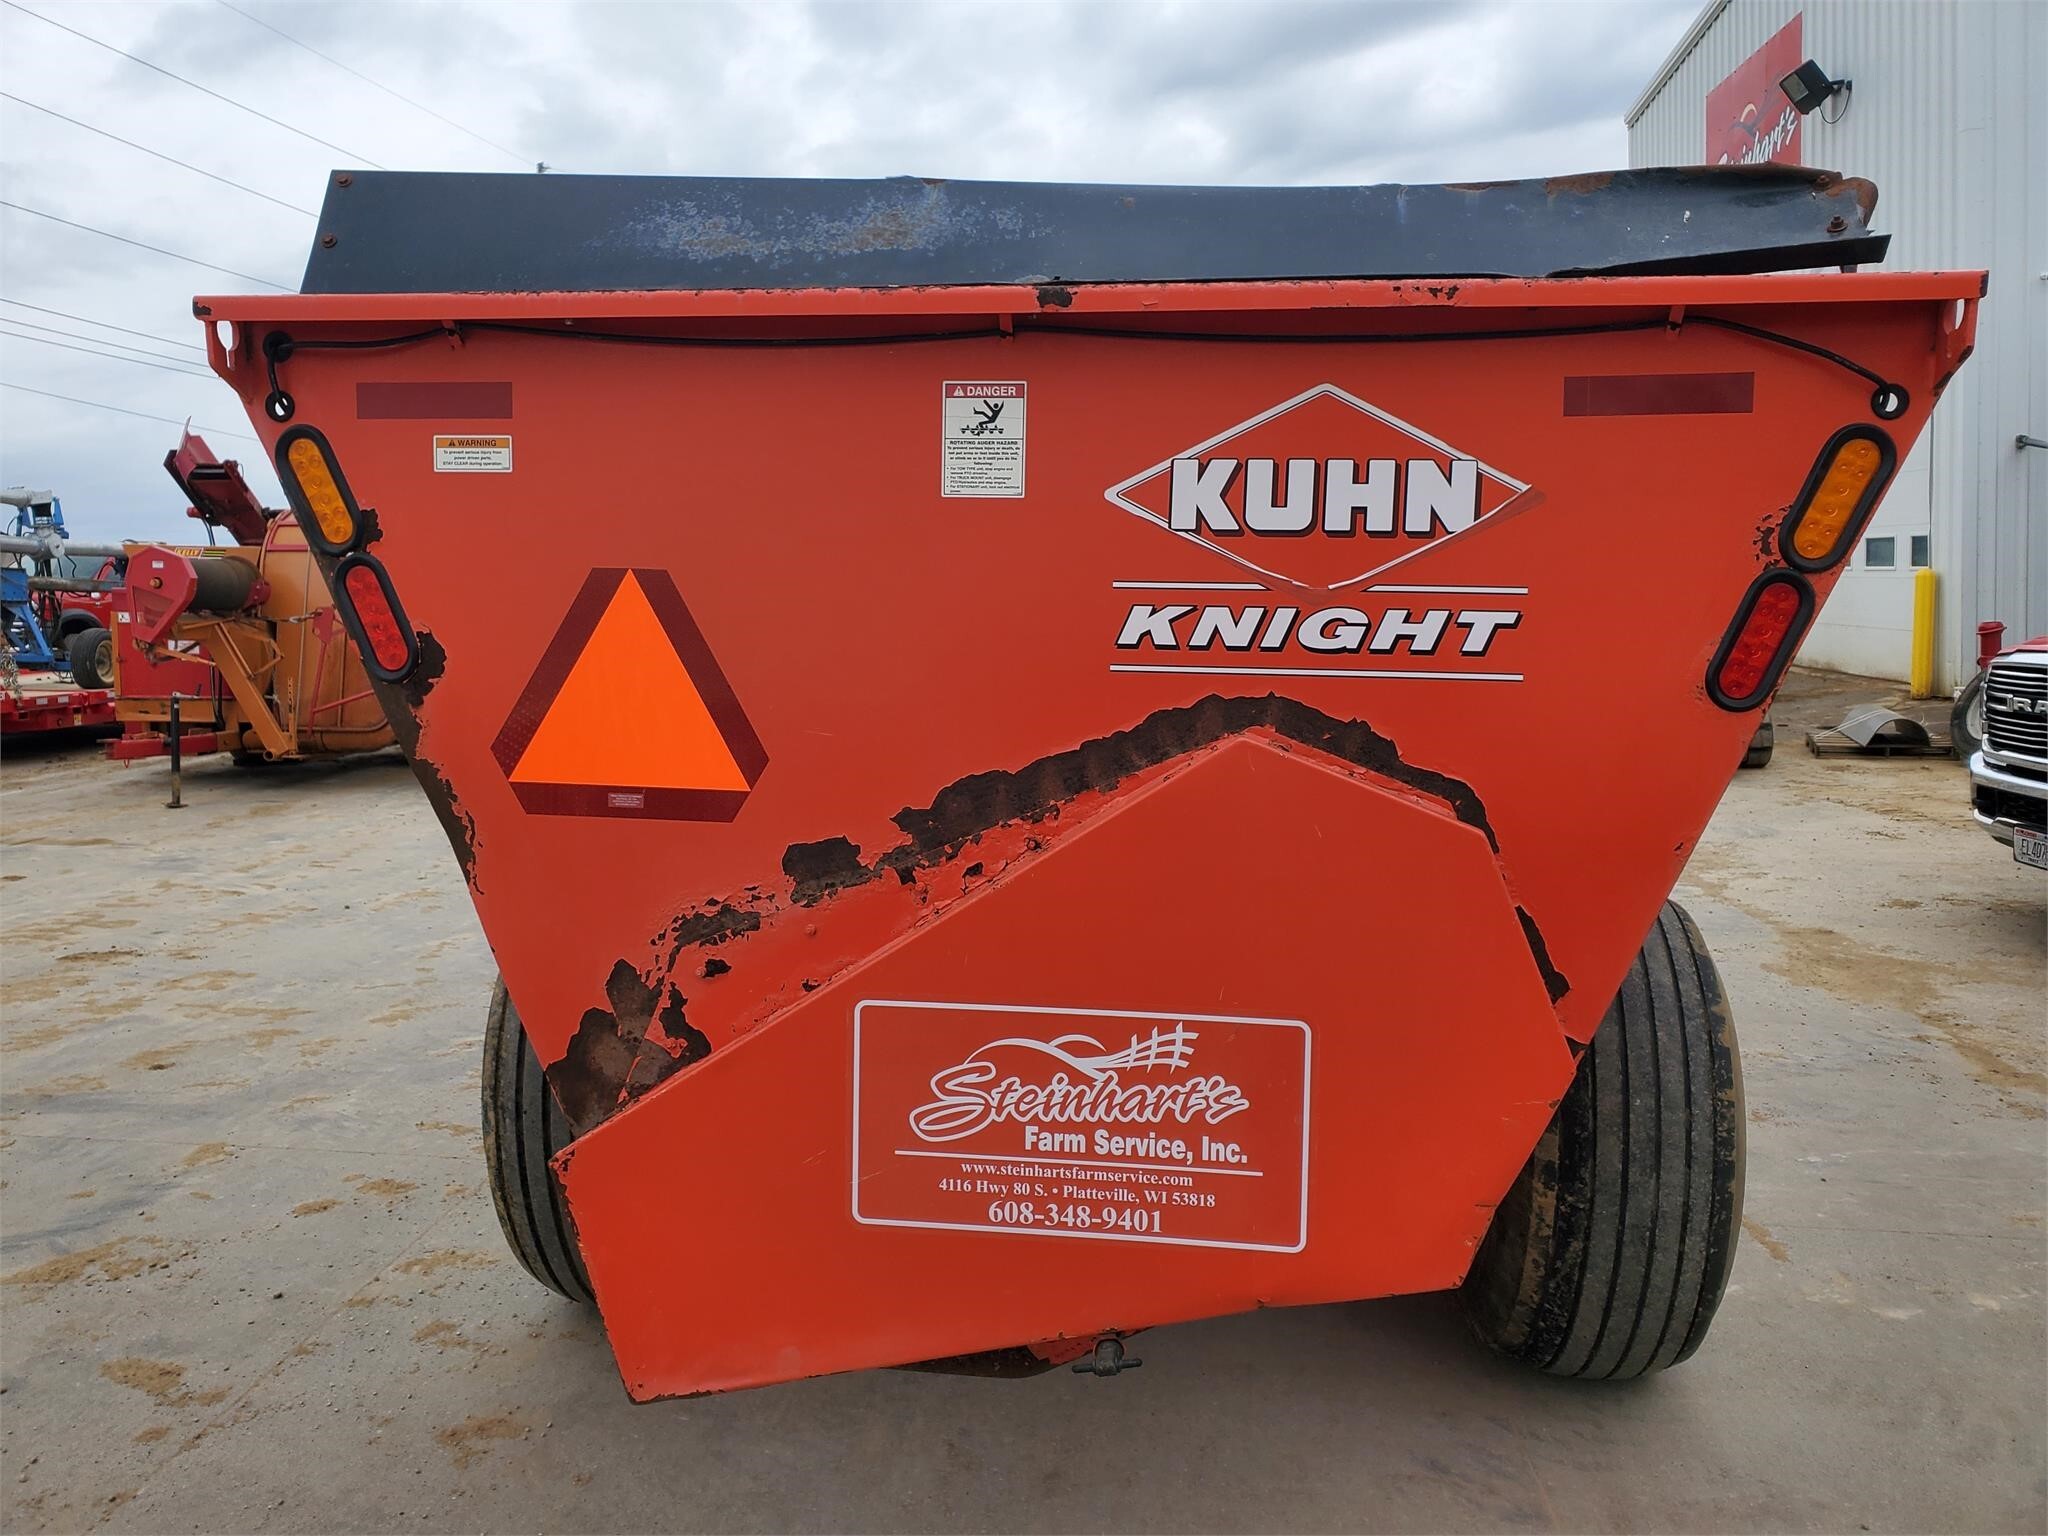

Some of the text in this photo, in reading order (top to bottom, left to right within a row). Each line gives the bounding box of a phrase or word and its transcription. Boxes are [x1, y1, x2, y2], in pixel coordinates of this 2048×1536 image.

[967, 386, 1016, 396] DANGER
[1170, 458, 1480, 536] KUHN
[1115, 604, 1521, 655] KNIGHT
[909, 1061, 1250, 1143] Steinhart's
[1025, 1125, 1249, 1166] Farm Service, Inc.
[960, 1160, 1194, 1187] www.steinhartsfarmservice.com
[938, 1178, 1216, 1208] 4116 Hwy 80 S. Platteville, WI 53818
[988, 1200, 1163, 1234] 608-348-9401
